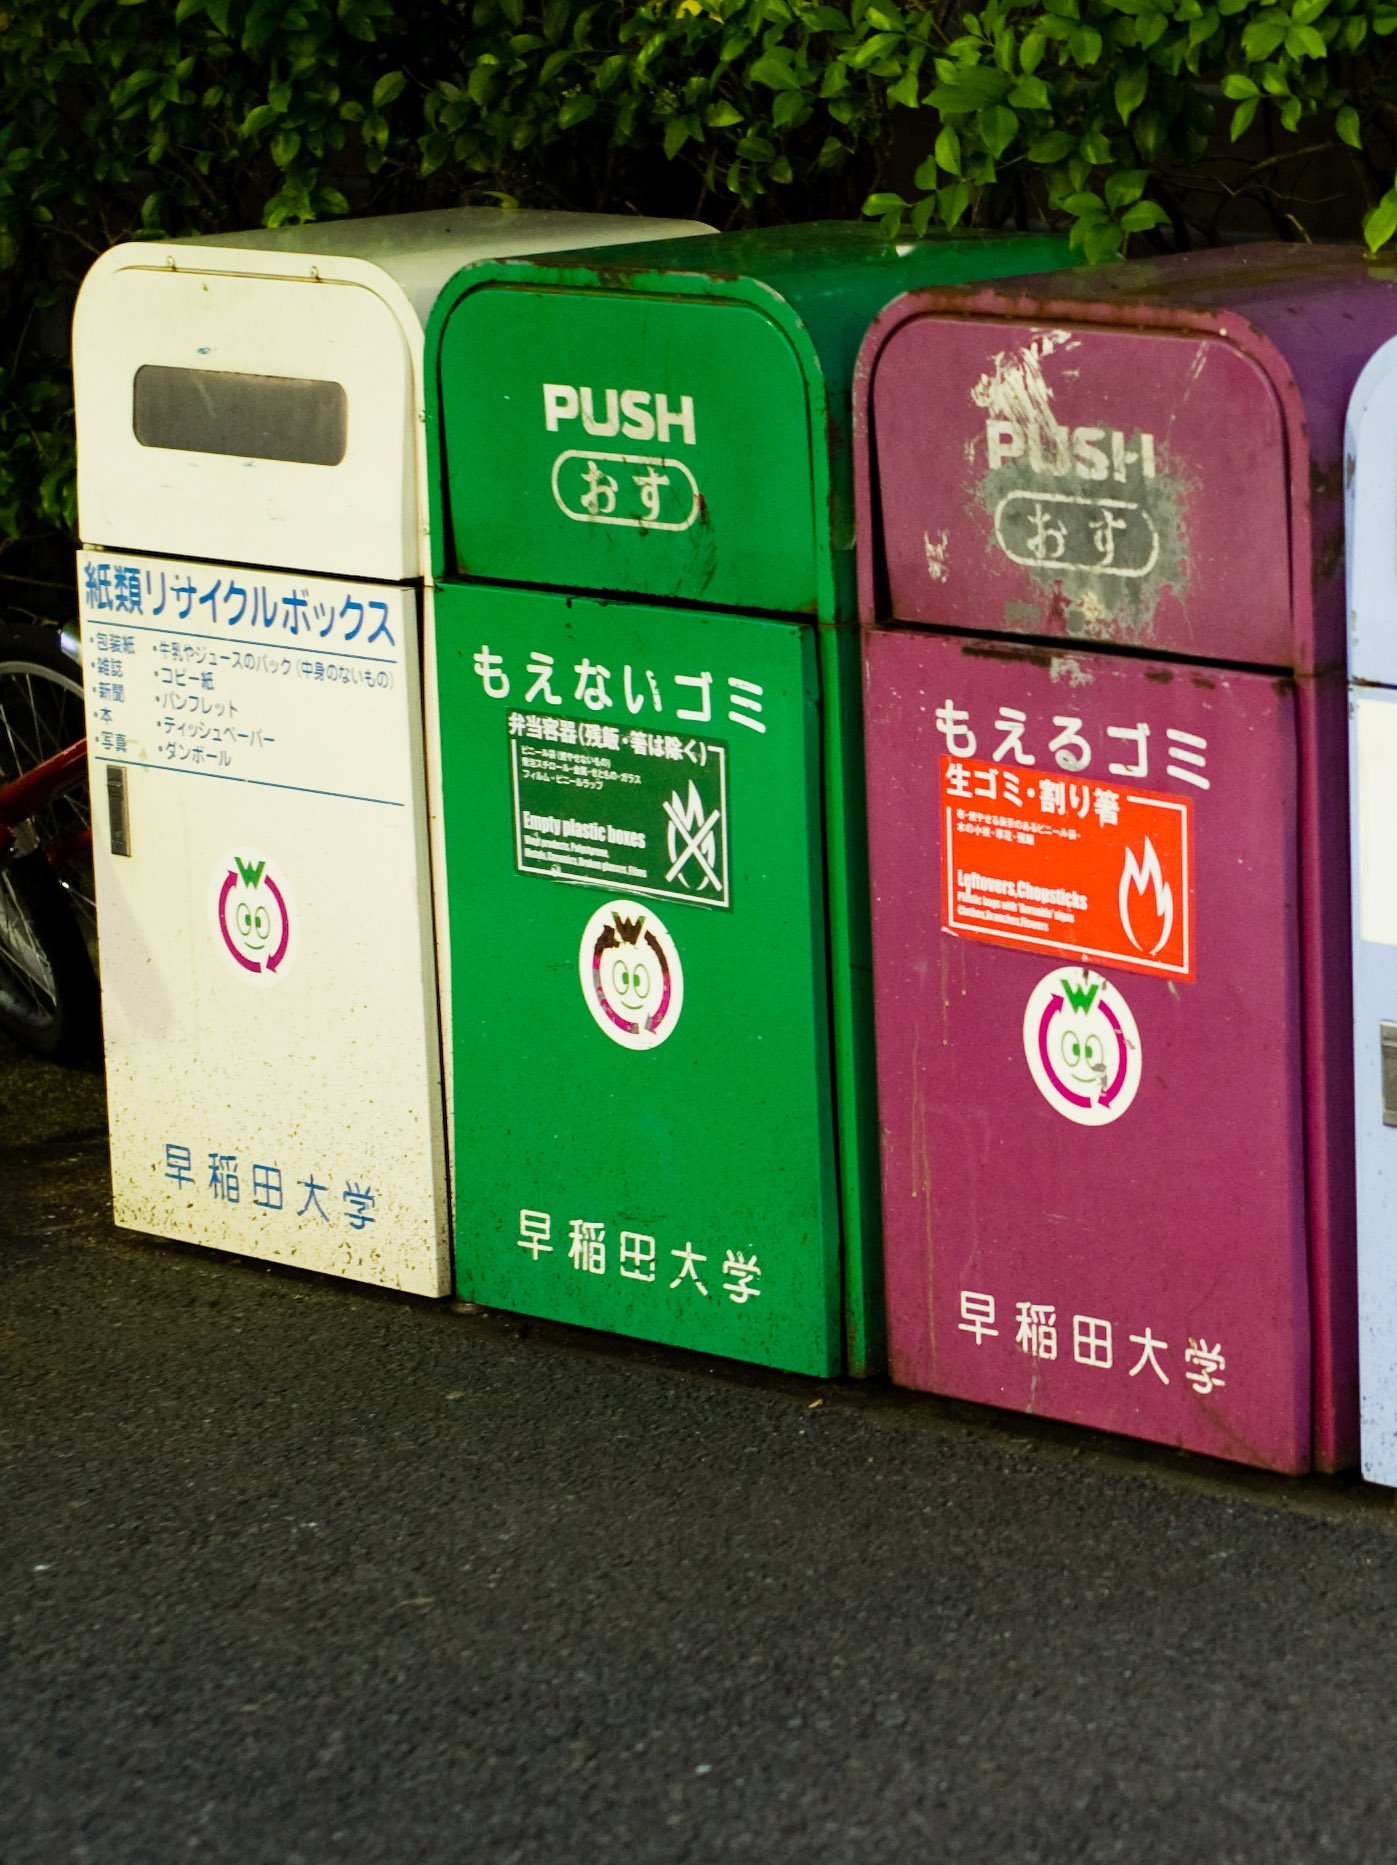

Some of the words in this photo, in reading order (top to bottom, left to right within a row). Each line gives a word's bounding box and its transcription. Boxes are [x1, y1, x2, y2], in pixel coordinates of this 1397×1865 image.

[542, 383, 697, 446] PUSH
[986, 419, 1157, 484] PUSH
[580, 460, 671, 521] おす
[1026, 503, 1127, 566] おす
[84, 561, 396, 647] 紙類リサイクルボックス
[473, 644, 767, 734] もえないゴミ
[935, 698, 1211, 790] もえるゴミ
[523, 810, 561, 836] Empty
[562, 818, 606, 842] plastic
[607, 824, 647, 849] boxes
[946, 763, 1121, 829] 生ゴミ・割り箸
[163, 1142, 377, 1231] 早稲田大学
[516, 1208, 762, 1304] 早稲田大学
[956, 1289, 1227, 1395] 早稲田大学
